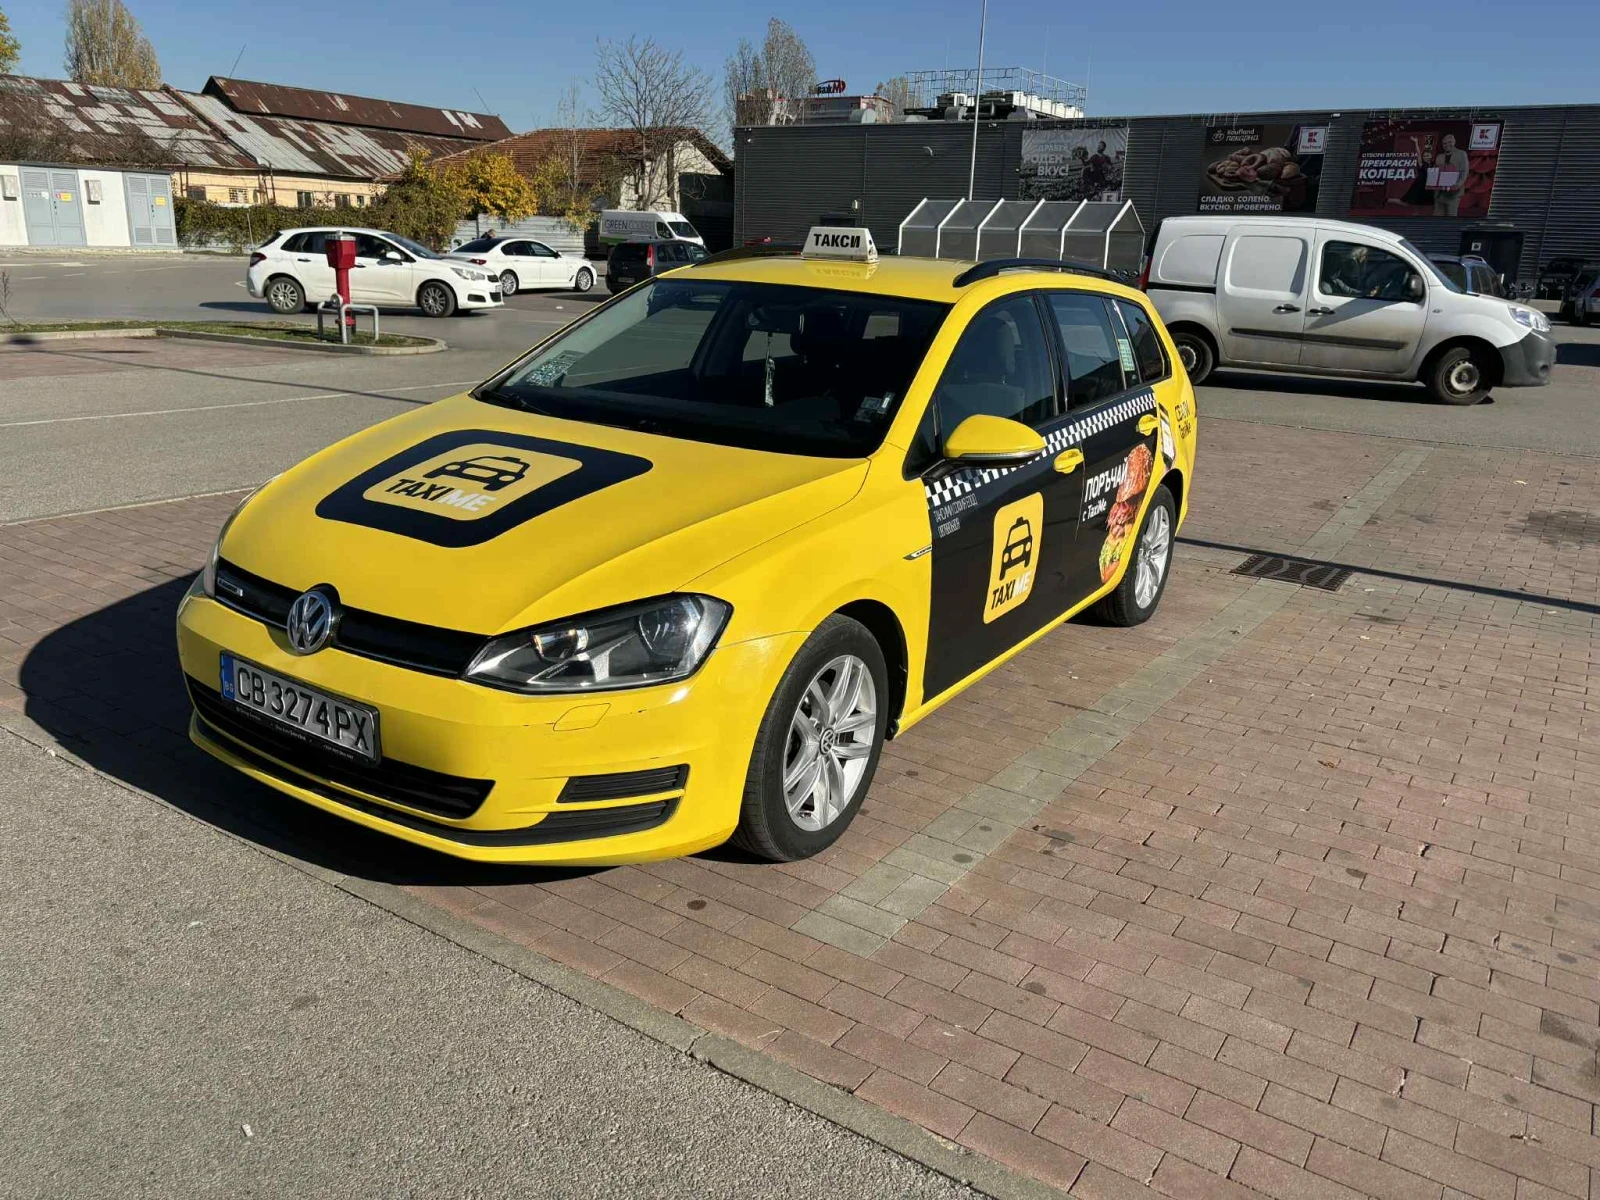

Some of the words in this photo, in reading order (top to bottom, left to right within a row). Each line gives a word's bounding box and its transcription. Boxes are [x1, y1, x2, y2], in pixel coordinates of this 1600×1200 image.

[1023, 154, 1063, 166] РОДЕН
[1360, 159, 1418, 168] ПРЕКРАСНА
[1038, 164, 1069, 176] ВКУС!
[1358, 168, 1416, 180] КОЛЕДА
[1201, 195, 1235, 203] СЛАДКО.
[604, 219, 628, 230] GREEN
[813, 233, 861, 248] ТАКСИ
[1087, 498, 1107, 519] TaxiMe
